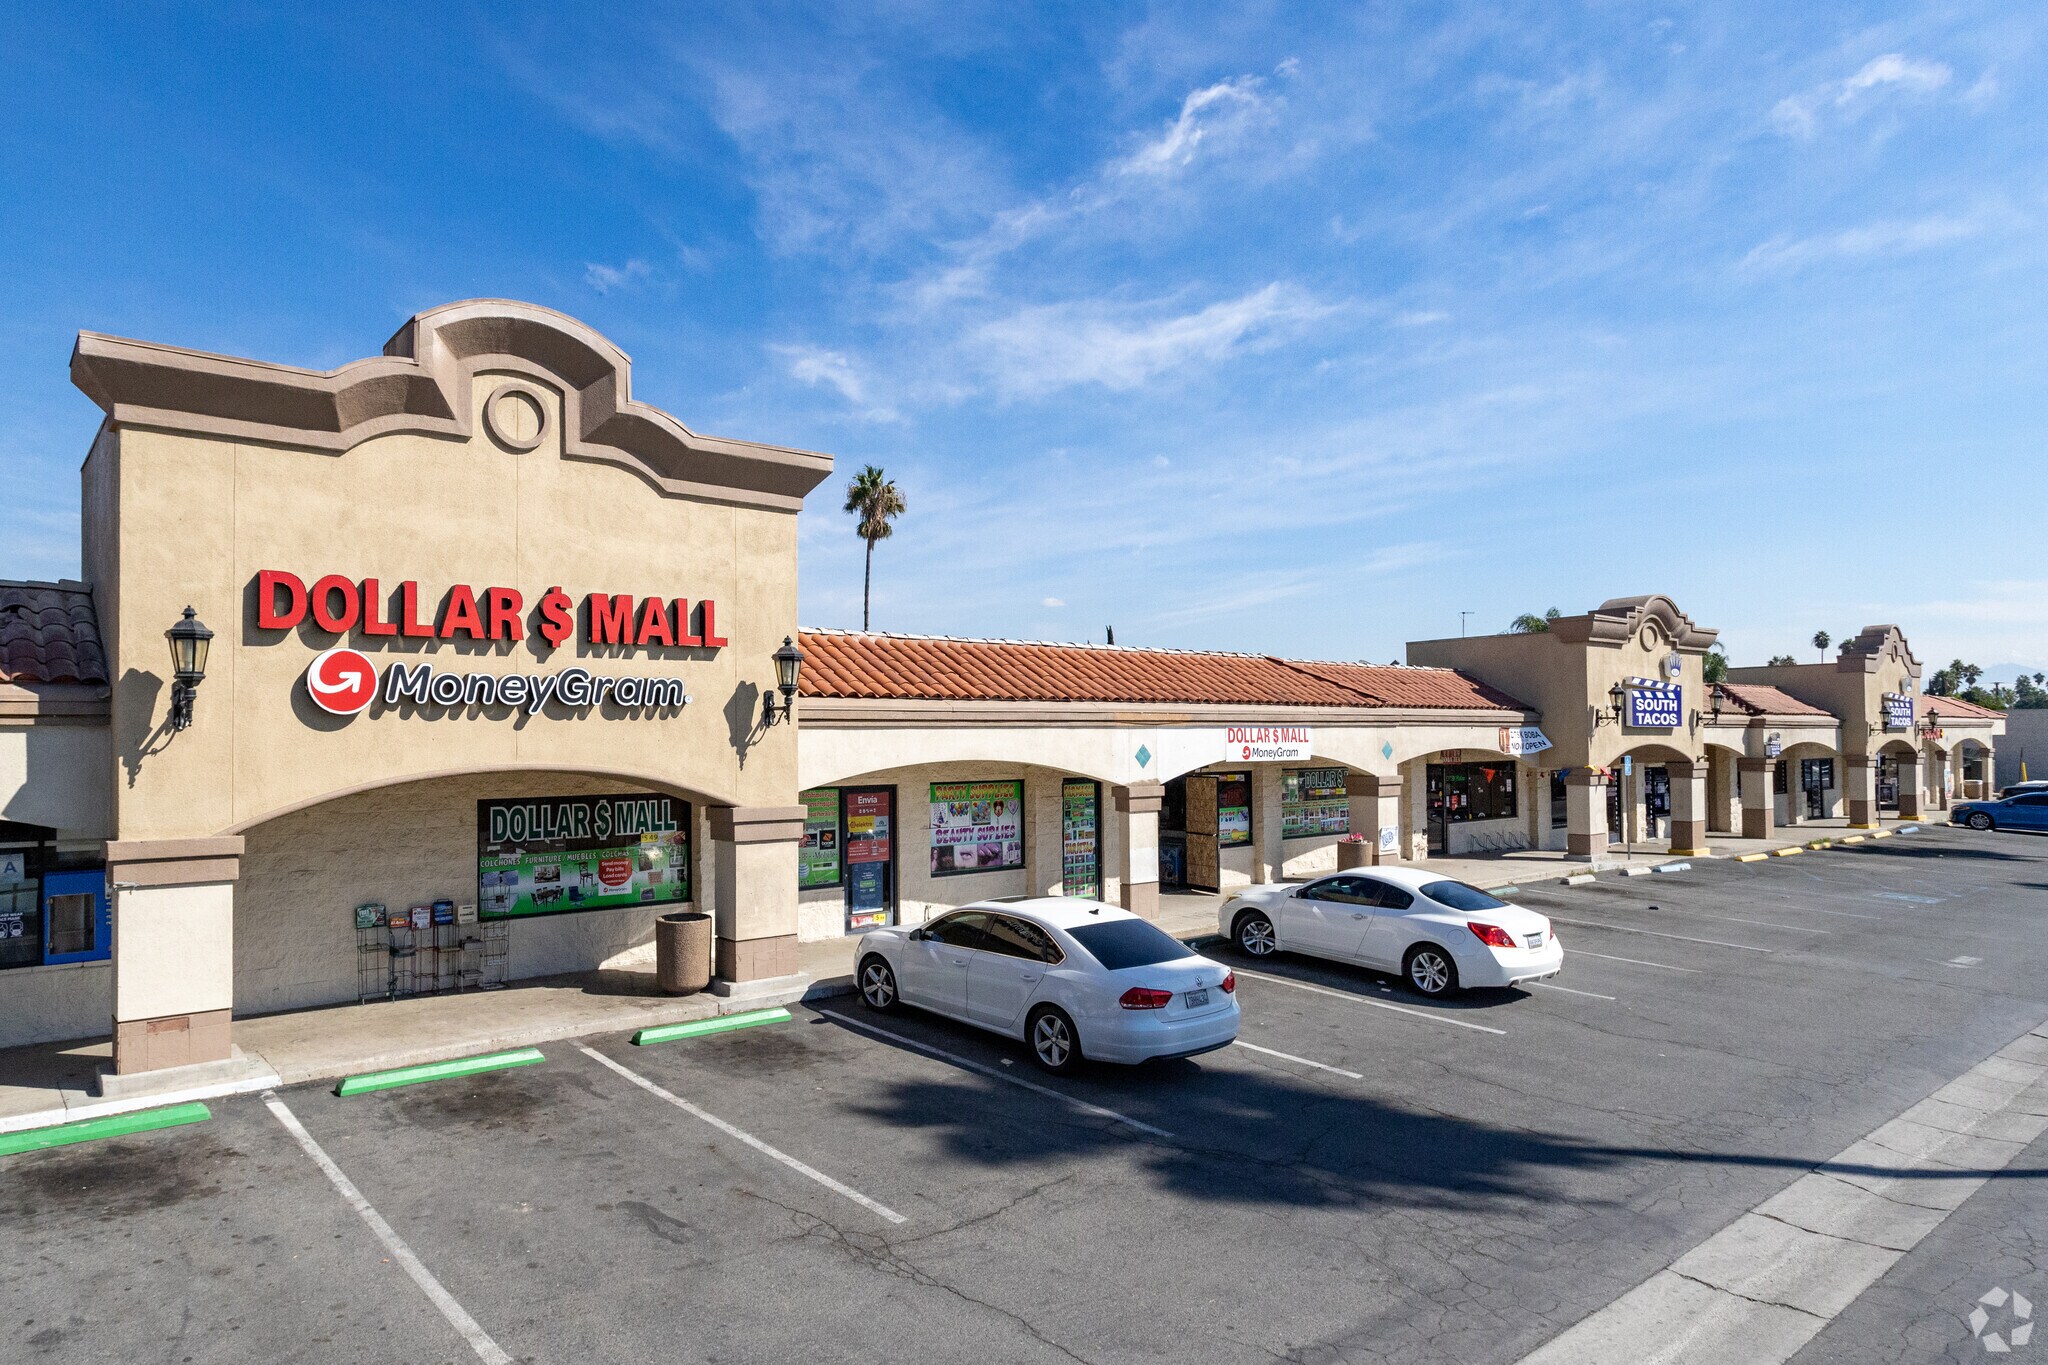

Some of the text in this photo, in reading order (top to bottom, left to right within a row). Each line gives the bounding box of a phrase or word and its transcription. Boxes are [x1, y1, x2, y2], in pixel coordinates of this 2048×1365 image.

[259, 569, 728, 648] DOLLAR $ MALL
[1636, 699, 1678, 712] SOUTH
[1891, 707, 1911, 717] SOUTH
[1636, 713, 1678, 726] TACOS
[1891, 717, 1911, 726] TACOS
[1227, 727, 1309, 744] DOLLAR $ MALL
[1524, 731, 1541, 739] BOBA
[1525, 739, 1547, 750] OPEN
[1252, 747, 1299, 760] MoneyGram
[1305, 771, 1336, 789] DOLLAR
[936, 783, 1015, 800] PARTY SUPPLIES
[490, 799, 677, 843] DOLLAR $ MALL
[936, 825, 1016, 844] BEAUTY SUPLIES
[480, 858, 520, 868] COLCHONES
[525, 855, 561, 864] FURNITURE
[567, 852, 597, 861] MUEBLES
[4, 861, 17, 874] A
